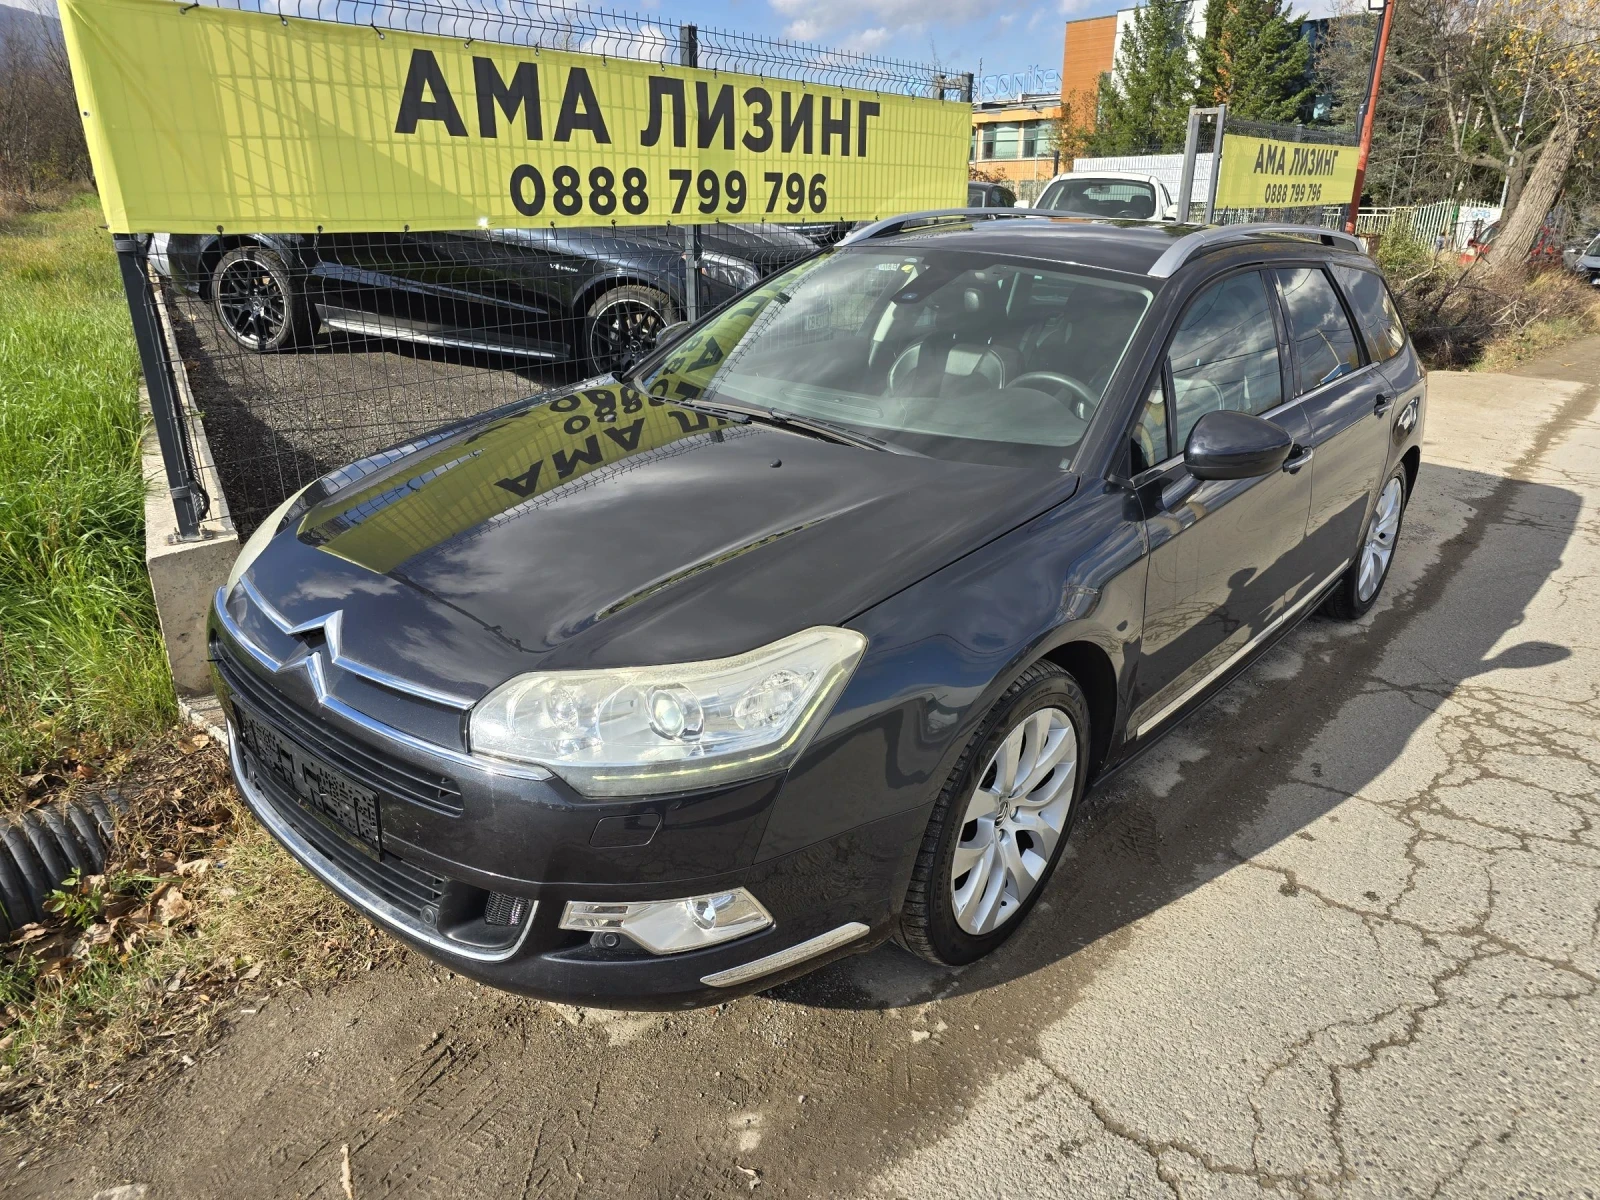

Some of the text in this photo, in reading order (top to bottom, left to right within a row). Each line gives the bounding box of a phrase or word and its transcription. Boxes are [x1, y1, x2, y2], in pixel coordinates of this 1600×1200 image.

[394, 48, 881, 158] АМА ЛИЗИНГ
[1253, 143, 1339, 176] АМА ЛИЗИНГ
[509, 164, 827, 217] 0888 799 796
[1264, 183, 1322, 203] 0888 799 796
